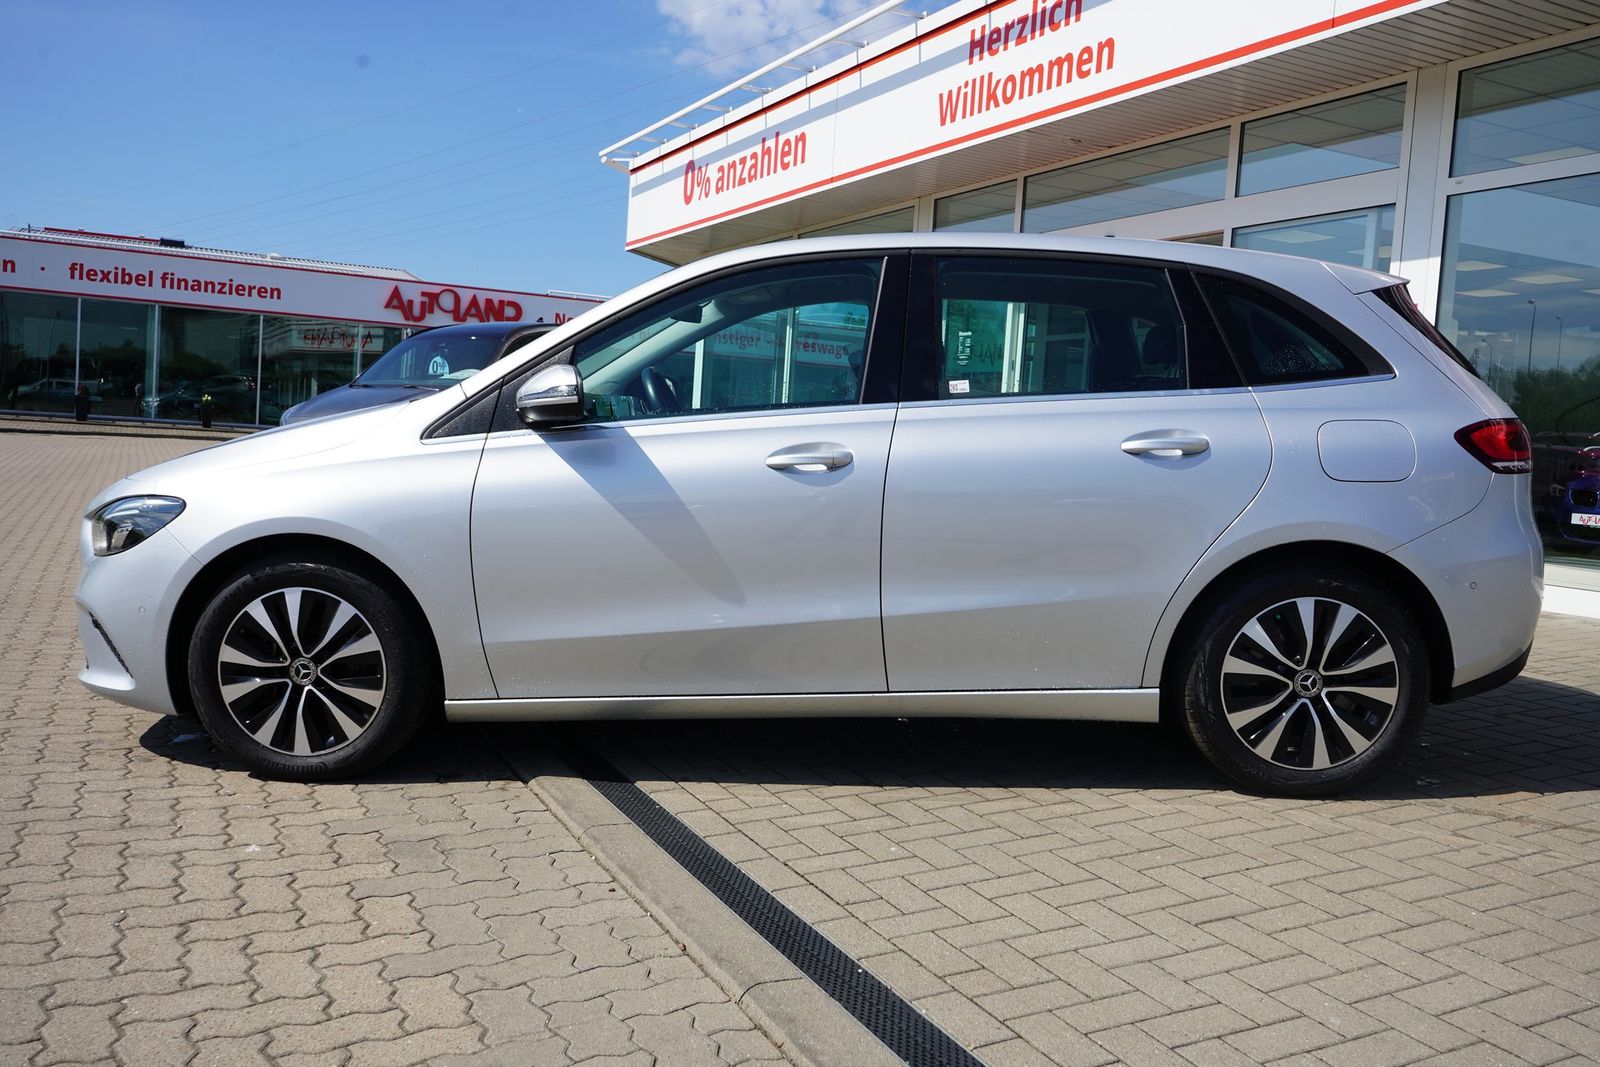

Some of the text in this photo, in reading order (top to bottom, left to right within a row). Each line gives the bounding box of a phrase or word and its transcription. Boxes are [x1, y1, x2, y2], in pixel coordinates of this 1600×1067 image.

[968, 0, 1083, 66] Herzlich
[938, 36, 1115, 127] Willkommen
[683, 131, 807, 205] 0% anzahlen
[0, 258, 282, 300] n flexibel finanzieren
[384, 285, 523, 323] AUTOLAND
[713, 329, 761, 350] nstiger
